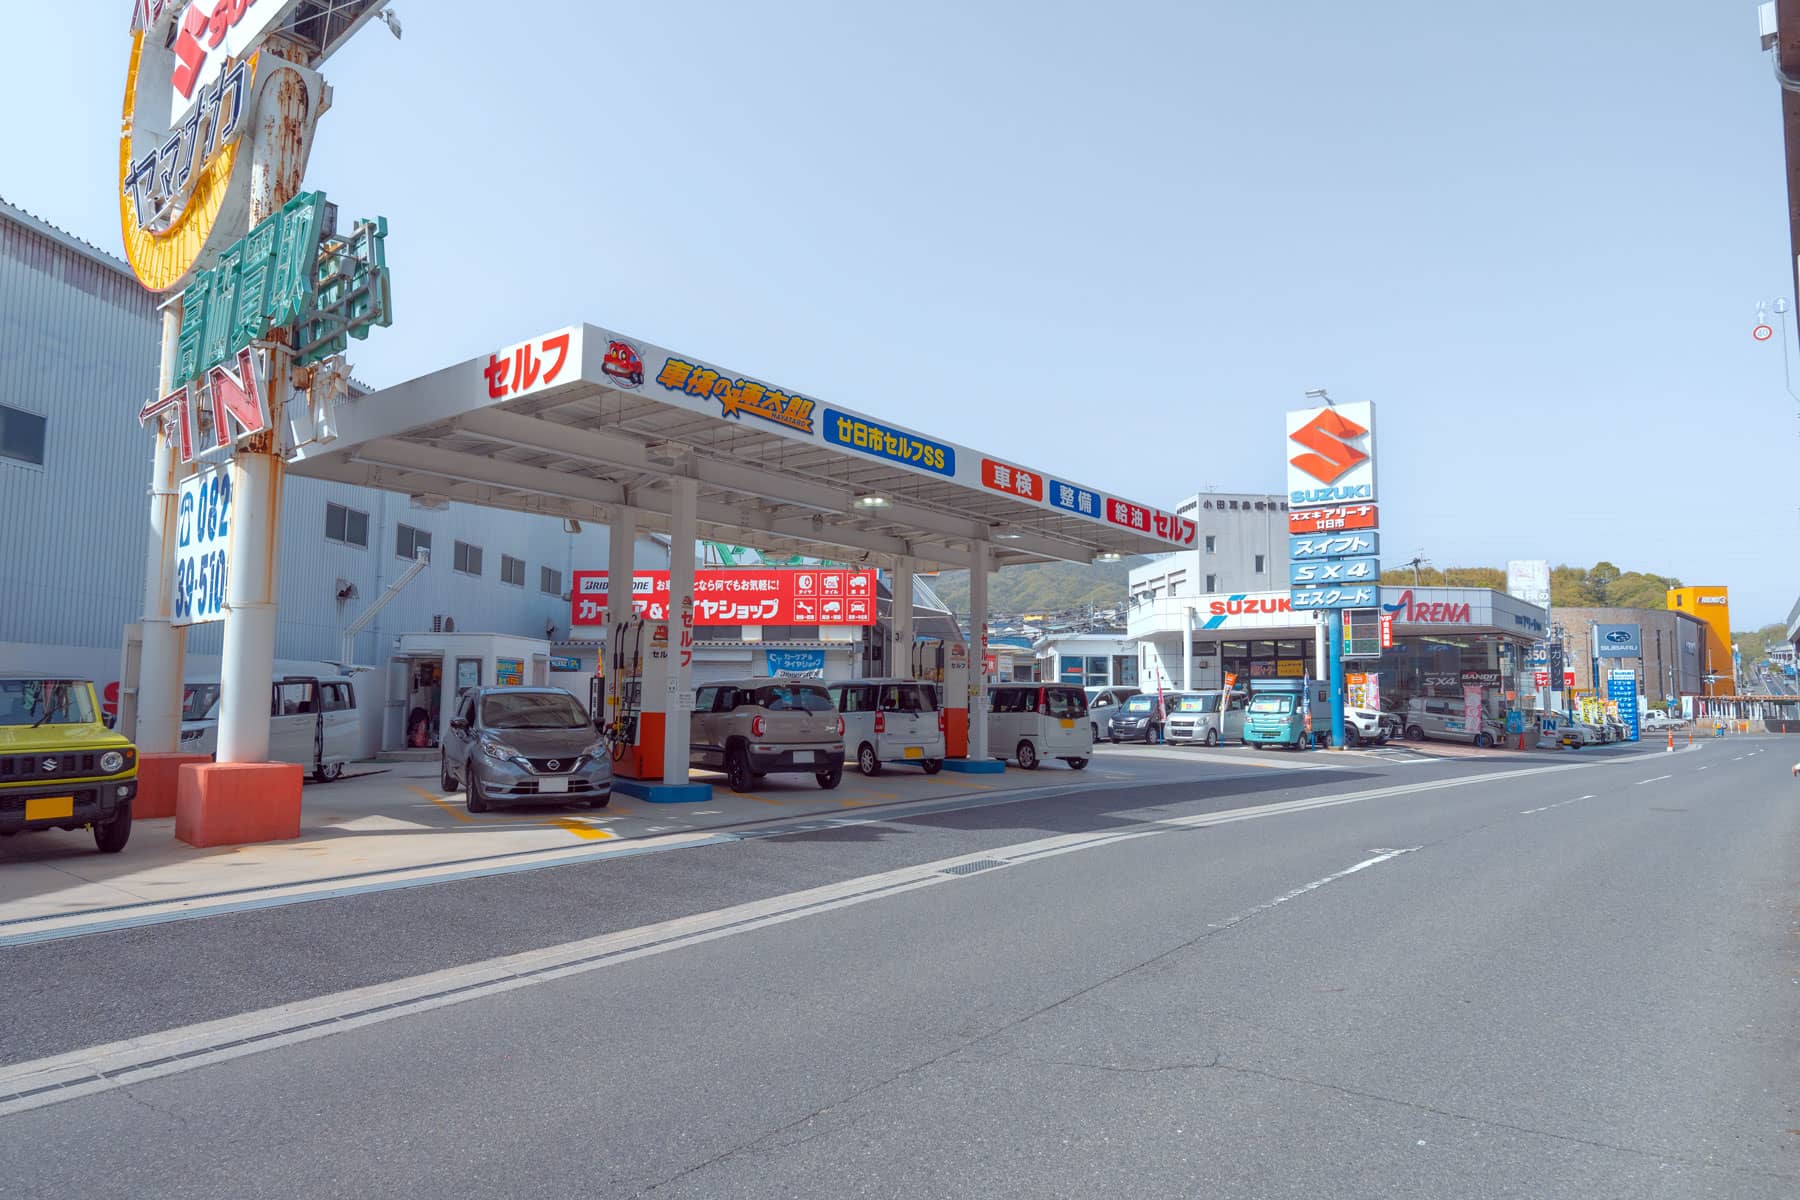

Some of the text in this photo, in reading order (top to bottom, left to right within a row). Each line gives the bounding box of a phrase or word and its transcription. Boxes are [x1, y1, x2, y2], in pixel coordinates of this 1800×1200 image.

[123, 59, 248, 228] ヤマナカ
[484, 333, 569, 399] セルフ
[836, 416, 945, 470] 廿日市セルフSS
[993, 465, 1033, 497] 車検
[1059, 484, 1092, 515] 整備
[1290, 484, 1371, 503] SUZUKI
[197, 472, 233, 543] 082
[1114, 502, 1144, 529] 給油
[1290, 506, 1371, 521] スズキアリーナ
[1153, 510, 1195, 544] セルフ
[1316, 518, 1345, 529] 廿日市
[1294, 536, 1370, 556] スイフト
[1295, 562, 1370, 580] SX4
[584, 581, 649, 590] BRIDONE
[1210, 598, 1296, 616] SUZUK
[1294, 588, 1372, 606] エスクード
[1389, 590, 1470, 622] ARENA
[680, 611, 693, 668] セルフ
[652, 650, 668, 659] セル
[1423, 677, 1458, 686] SX4
[1542, 719, 1557, 730] IN
